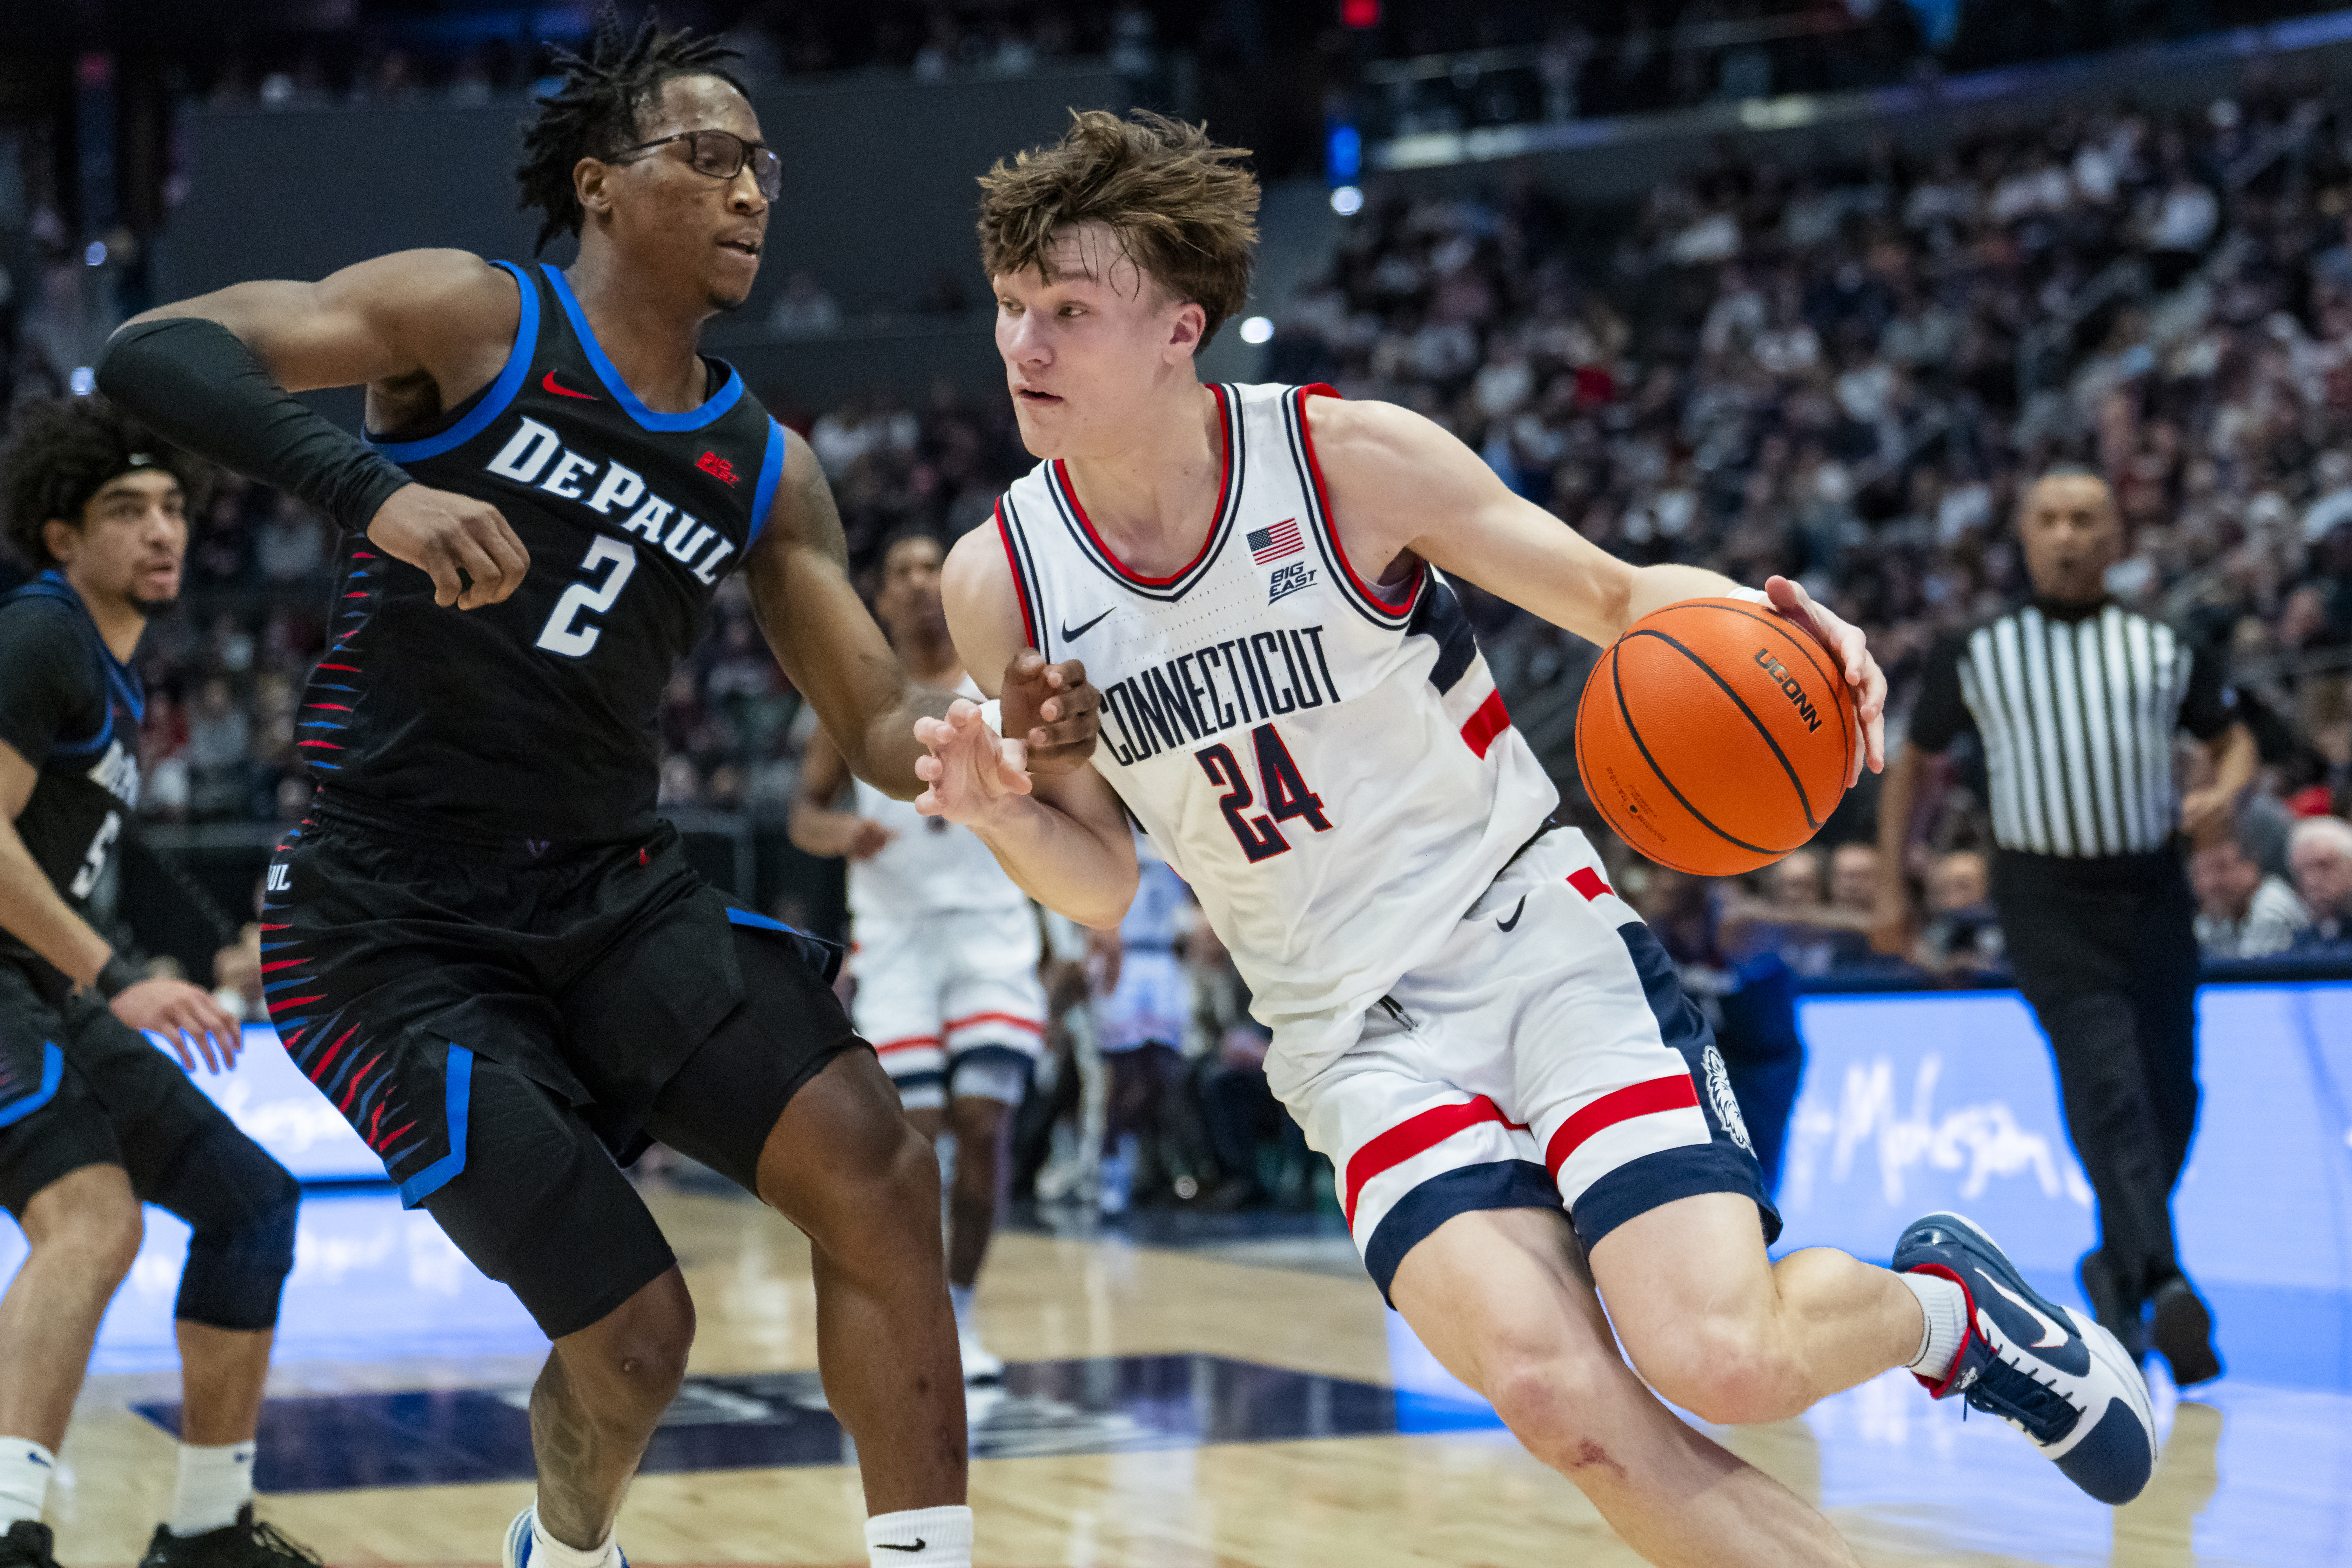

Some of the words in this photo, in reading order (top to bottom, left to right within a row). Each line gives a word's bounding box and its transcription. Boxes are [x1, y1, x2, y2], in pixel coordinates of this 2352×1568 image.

[535, 534, 637, 657] 2
[1269, 569, 1316, 597] EAST
[1271, 561, 1304, 584] BIG
[1098, 625, 1341, 766] CONNECTICUT
[1194, 723, 1333, 864] 24
